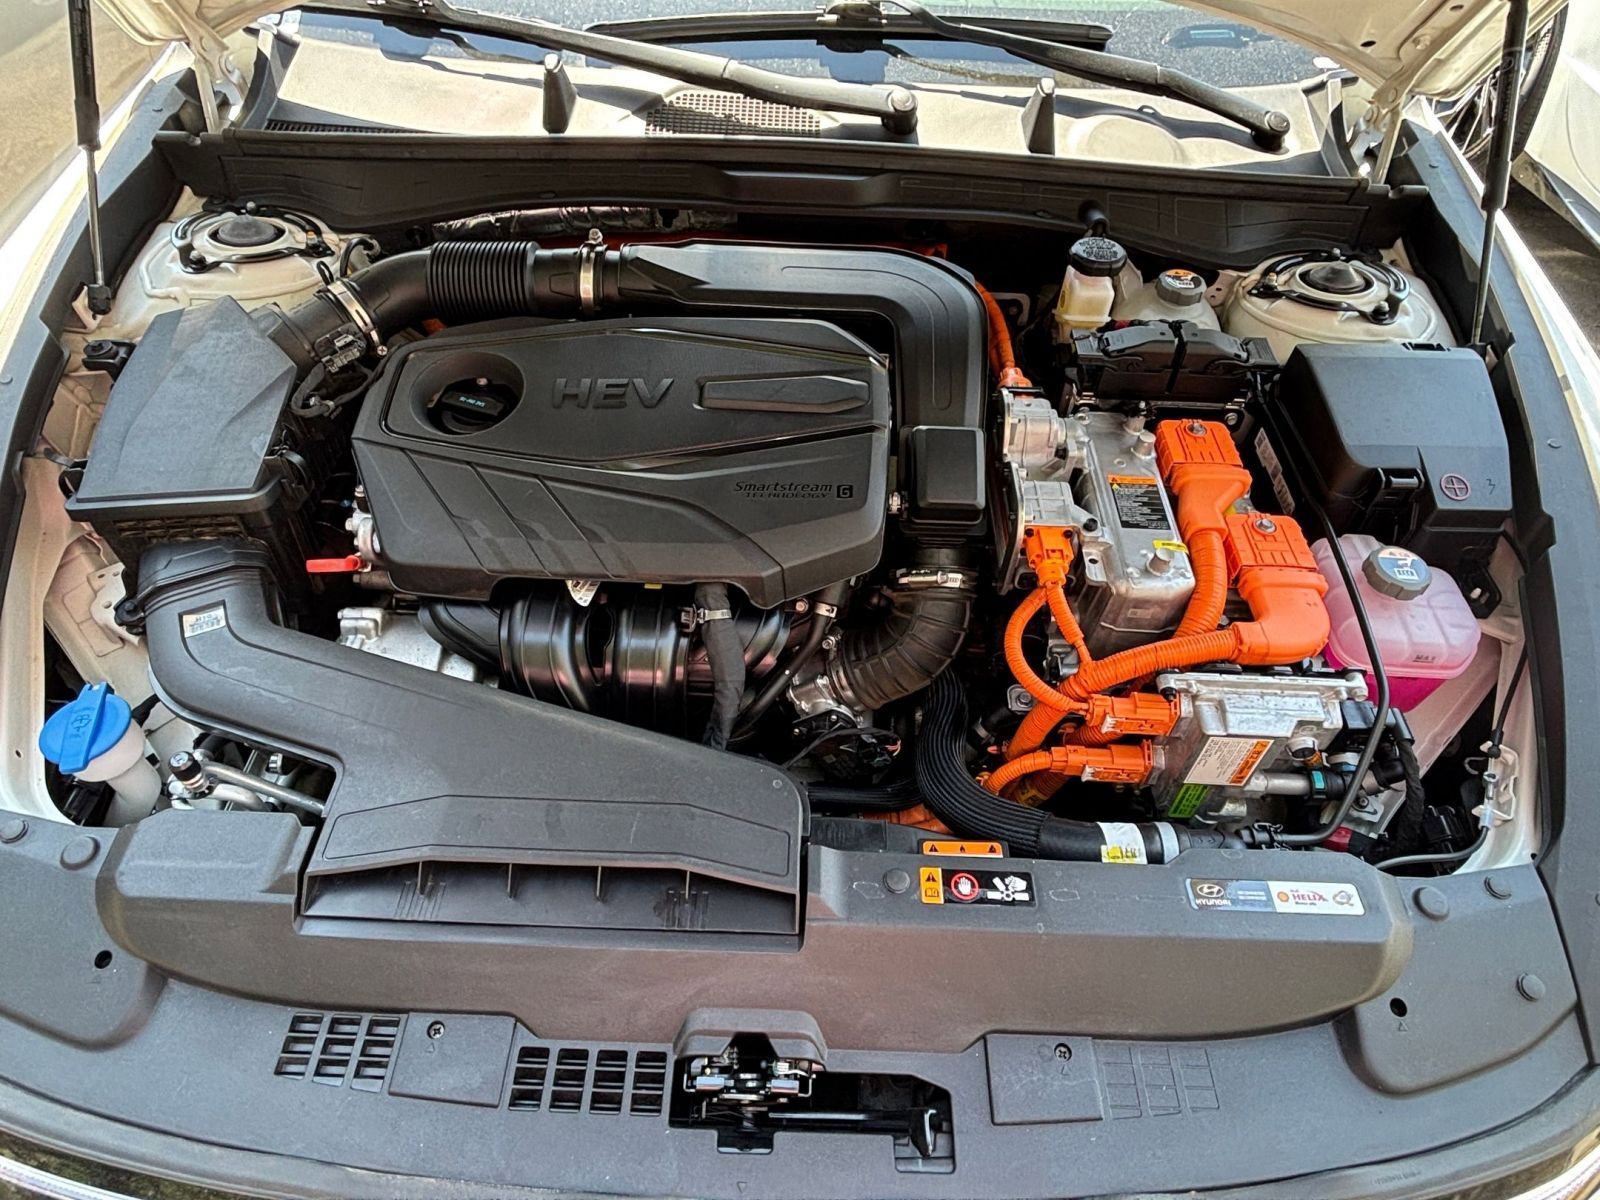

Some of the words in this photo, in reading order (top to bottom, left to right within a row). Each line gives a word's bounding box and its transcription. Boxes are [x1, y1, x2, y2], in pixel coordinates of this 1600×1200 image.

[552, 378, 675, 409] HEV
[734, 481, 833, 493] Smartstream
[1195, 898, 1232, 906] HYUNDAI
